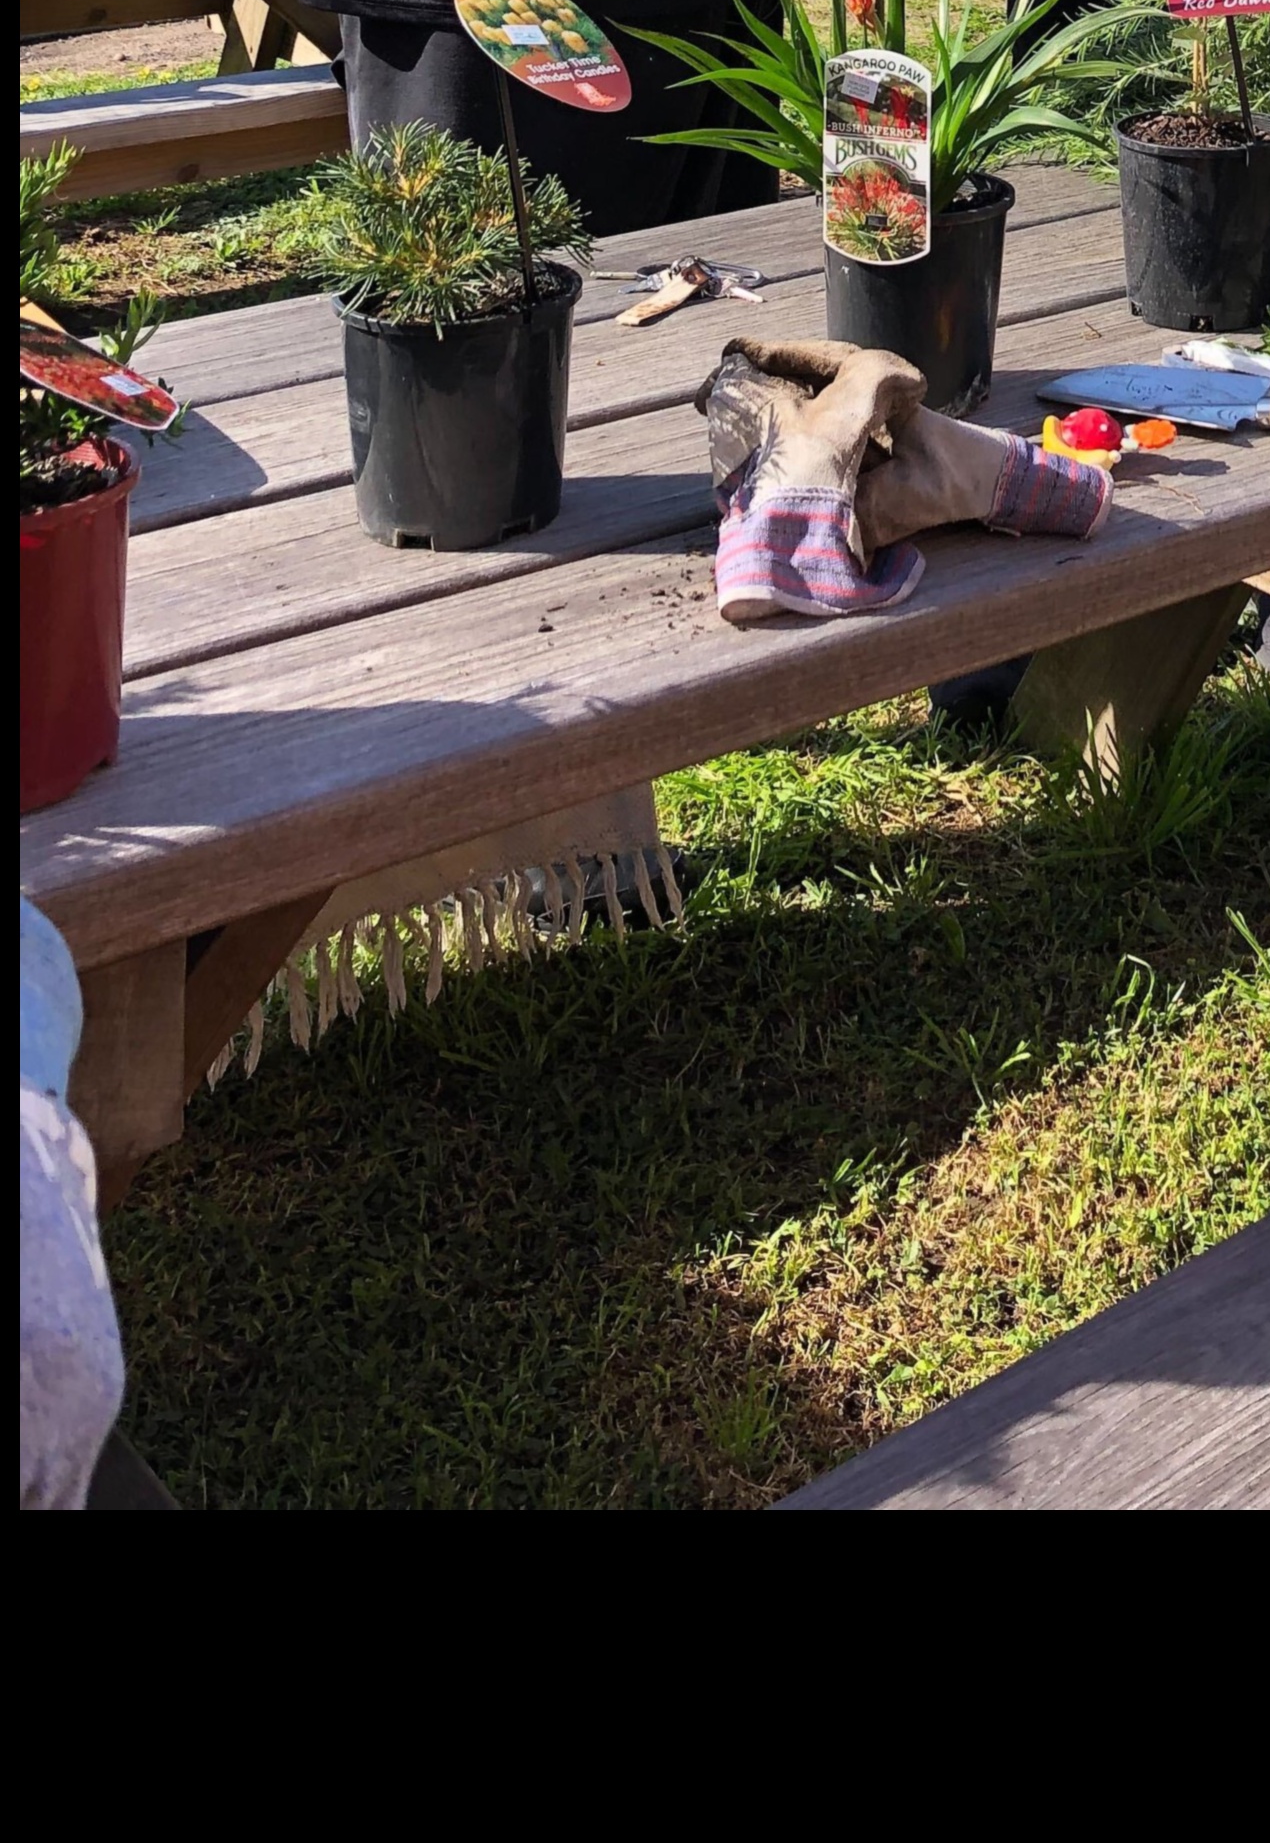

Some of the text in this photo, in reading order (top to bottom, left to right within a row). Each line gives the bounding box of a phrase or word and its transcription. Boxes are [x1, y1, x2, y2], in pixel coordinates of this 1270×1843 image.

[526, 56, 601, 73] Tucker Time
[527, 64, 621, 85] Birthday Candles
[828, 58, 925, 84] KANGAROO PAW
[832, 122, 860, 133] BUSH
[836, 138, 917, 170] BUSH GEMS
